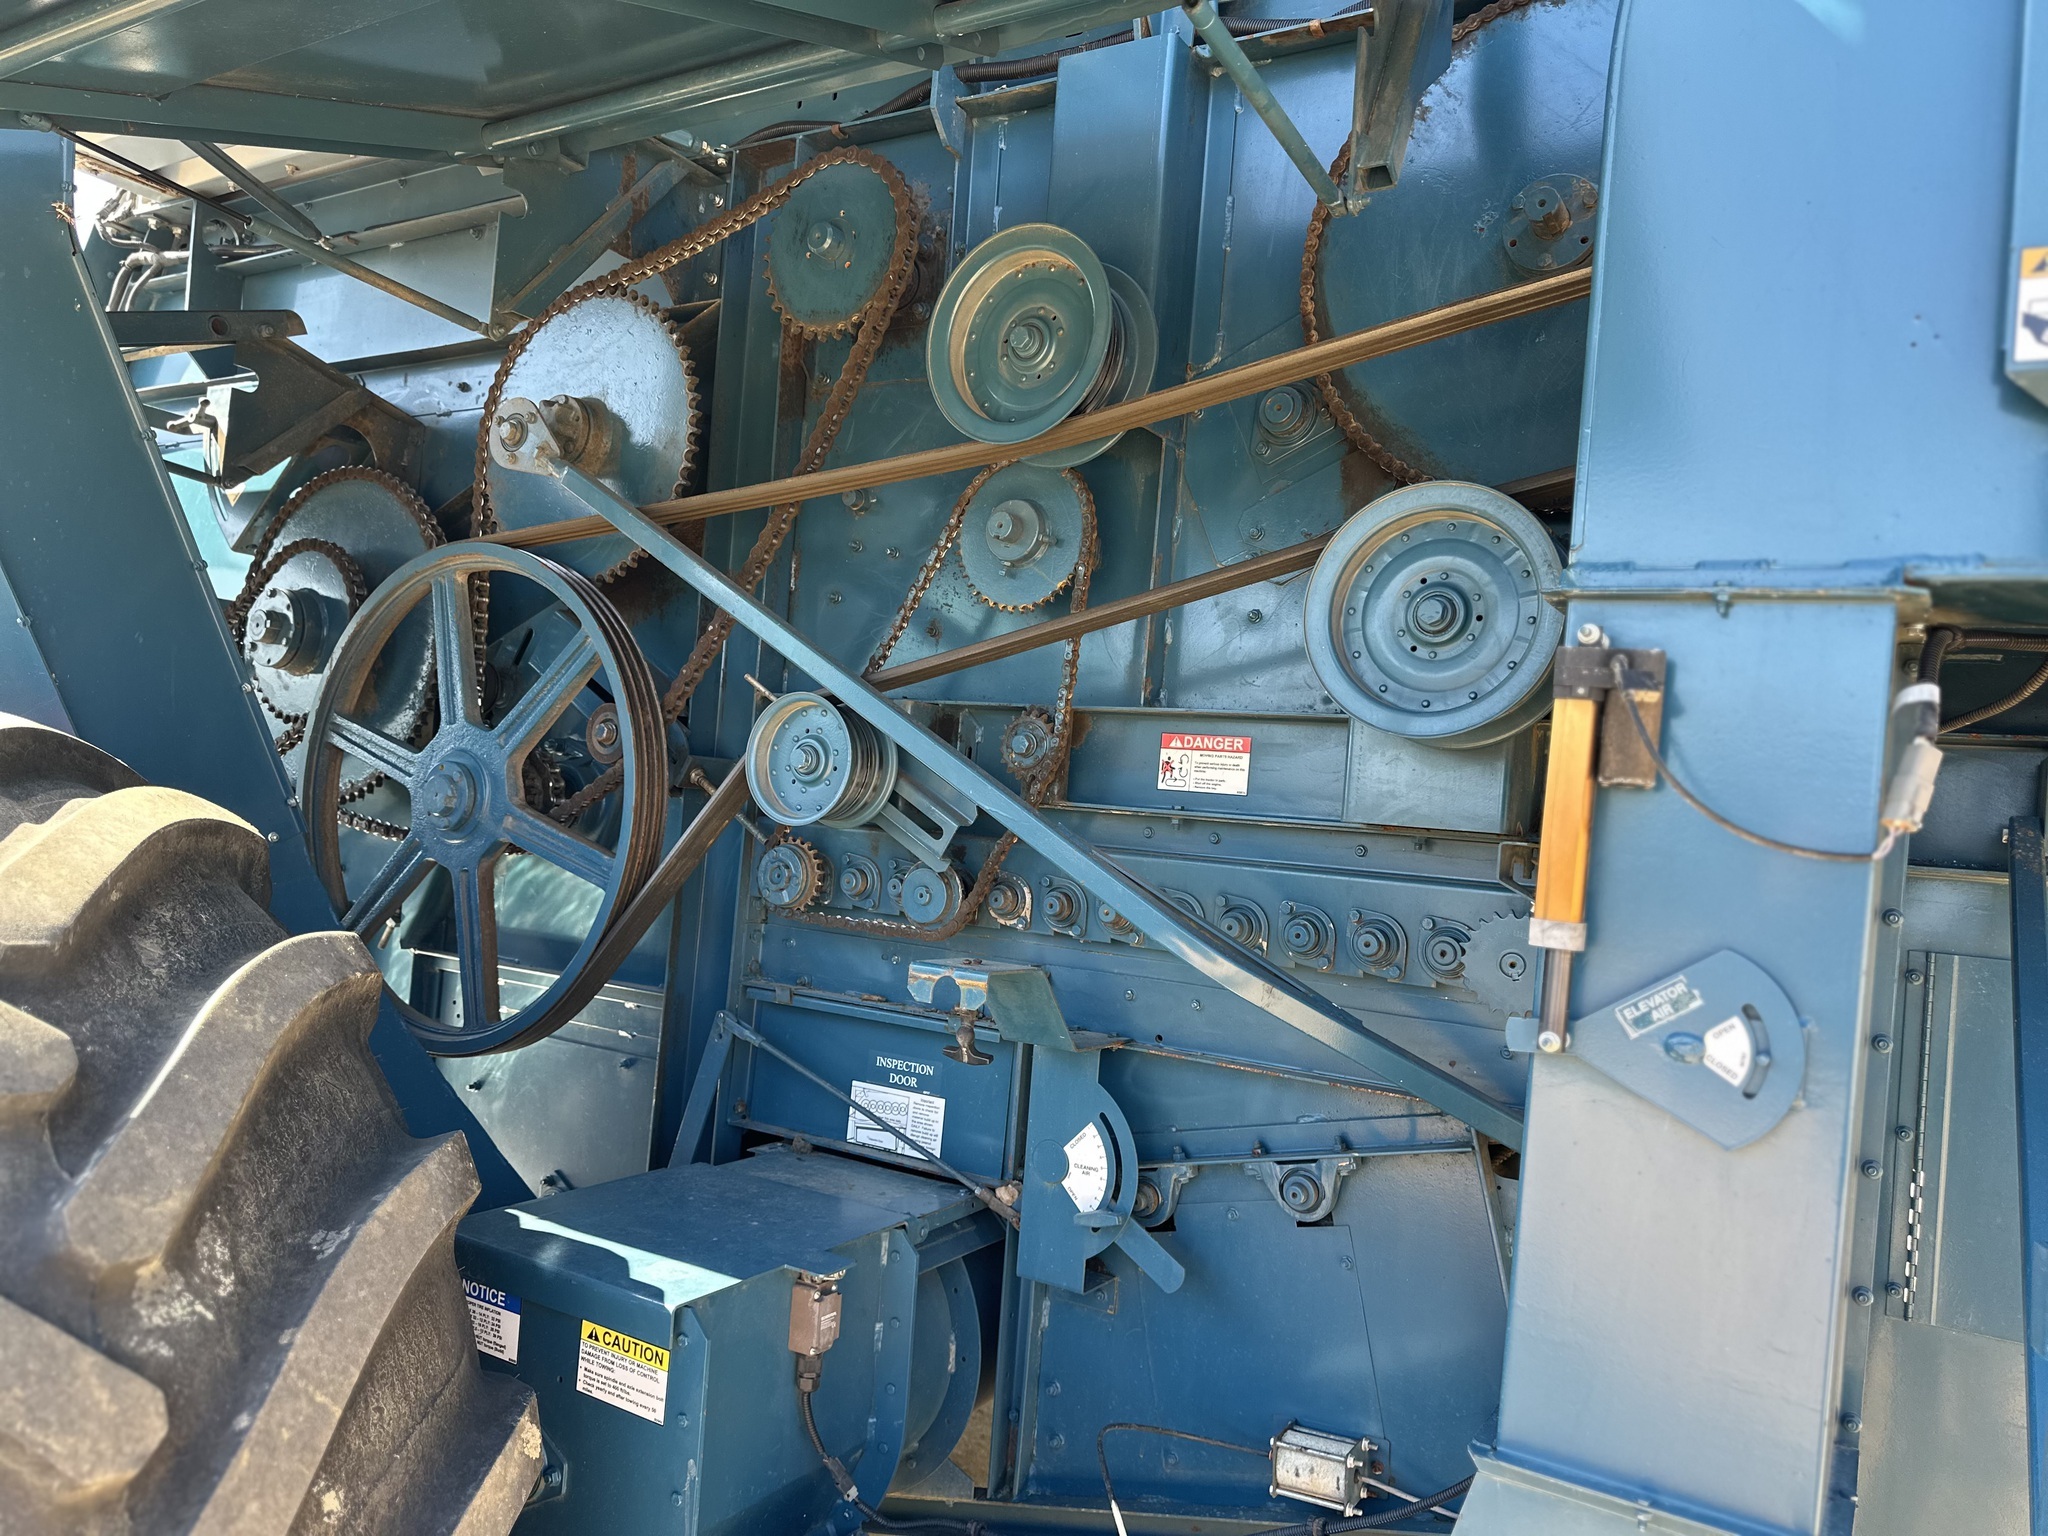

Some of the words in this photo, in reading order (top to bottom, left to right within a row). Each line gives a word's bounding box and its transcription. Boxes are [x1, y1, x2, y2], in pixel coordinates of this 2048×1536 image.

[1184, 736, 1244, 751] DANGER
[1623, 982, 1687, 1019] ELEVATOR
[1651, 1003, 1675, 1021] AIR
[1712, 1023, 1736, 1040] OPEN
[876, 1056, 934, 1075] INSPECTION
[1706, 1054, 1739, 1080] CLOSED
[889, 1073, 917, 1087] DOOR
[1070, 1132, 1087, 1149] CLOSED
[1074, 1163, 1099, 1172] CLEANING
[1067, 1186, 1078, 1201] OPEN
[462, 1279, 506, 1306] NOTICE
[602, 1330, 664, 1367] CAUTION
[581, 1349, 601, 1361] DAMAGE
[602, 1357, 615, 1366] FROM
[616, 1362, 628, 1371] LOSS
[581, 1356, 595, 1366] WHILE
[589, 1344, 610, 1357] PREVENT
[611, 1352, 627, 1363] INJURY
[636, 1362, 658, 1375] MACHINE
[583, 1374, 596, 1383] torque
[604, 1375, 618, 1385] spindle
[636, 1388, 655, 1399] extension
[583, 1380, 594, 1388] Check
[595, 1385, 607, 1394] yearly
[626, 1397, 639, 1407] towing
[640, 1404, 650, 1412] every
